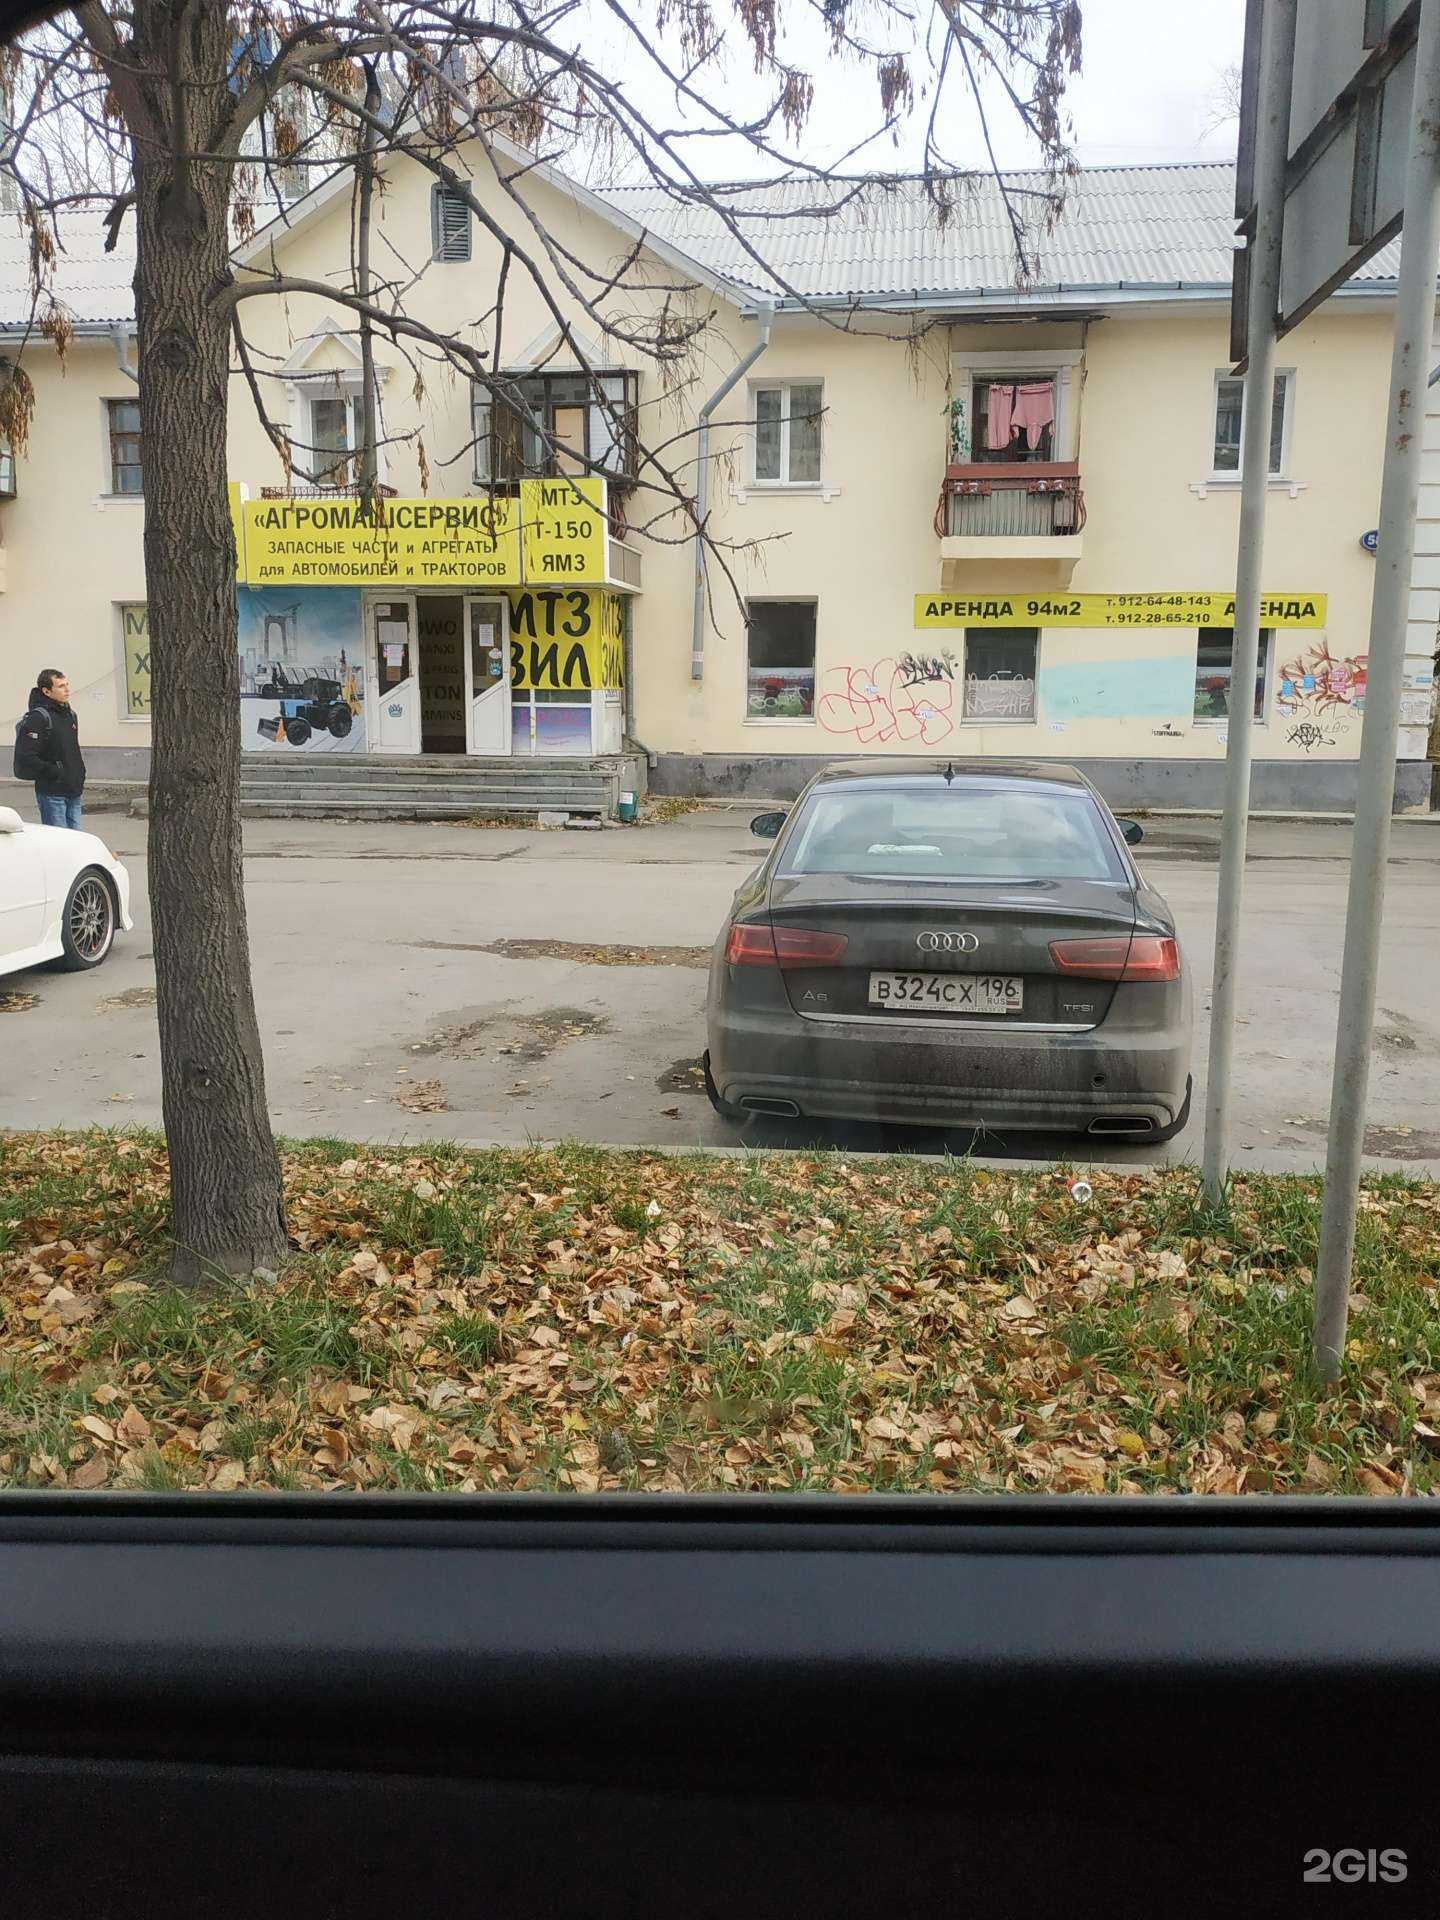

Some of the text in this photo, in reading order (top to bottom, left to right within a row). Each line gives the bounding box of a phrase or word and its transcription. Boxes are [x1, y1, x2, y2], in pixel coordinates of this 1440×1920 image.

[542, 488, 583, 506] МТЗ
[533, 521, 592, 539] Т-150
[268, 541, 496, 554] ЗАПАСНЫЕ ЧАСТИ и АГРЕГАТЫ
[259, 560, 506, 577] для АВТОМОБИЛЕЙ и ТРАКТОРОВ
[542, 554, 585, 572] ЯМЗ
[1118, 597, 1212, 606] 912-64-48-143
[925, 601, 1316, 620] АРЕНДА 94м2 АЕНДА
[1118, 613, 1210, 623] 912-28-65-210
[802, 989, 828, 1001] A6
[877, 976, 1016, 1003] В324СХ 196
[987, 997, 1006, 1006] RUS
